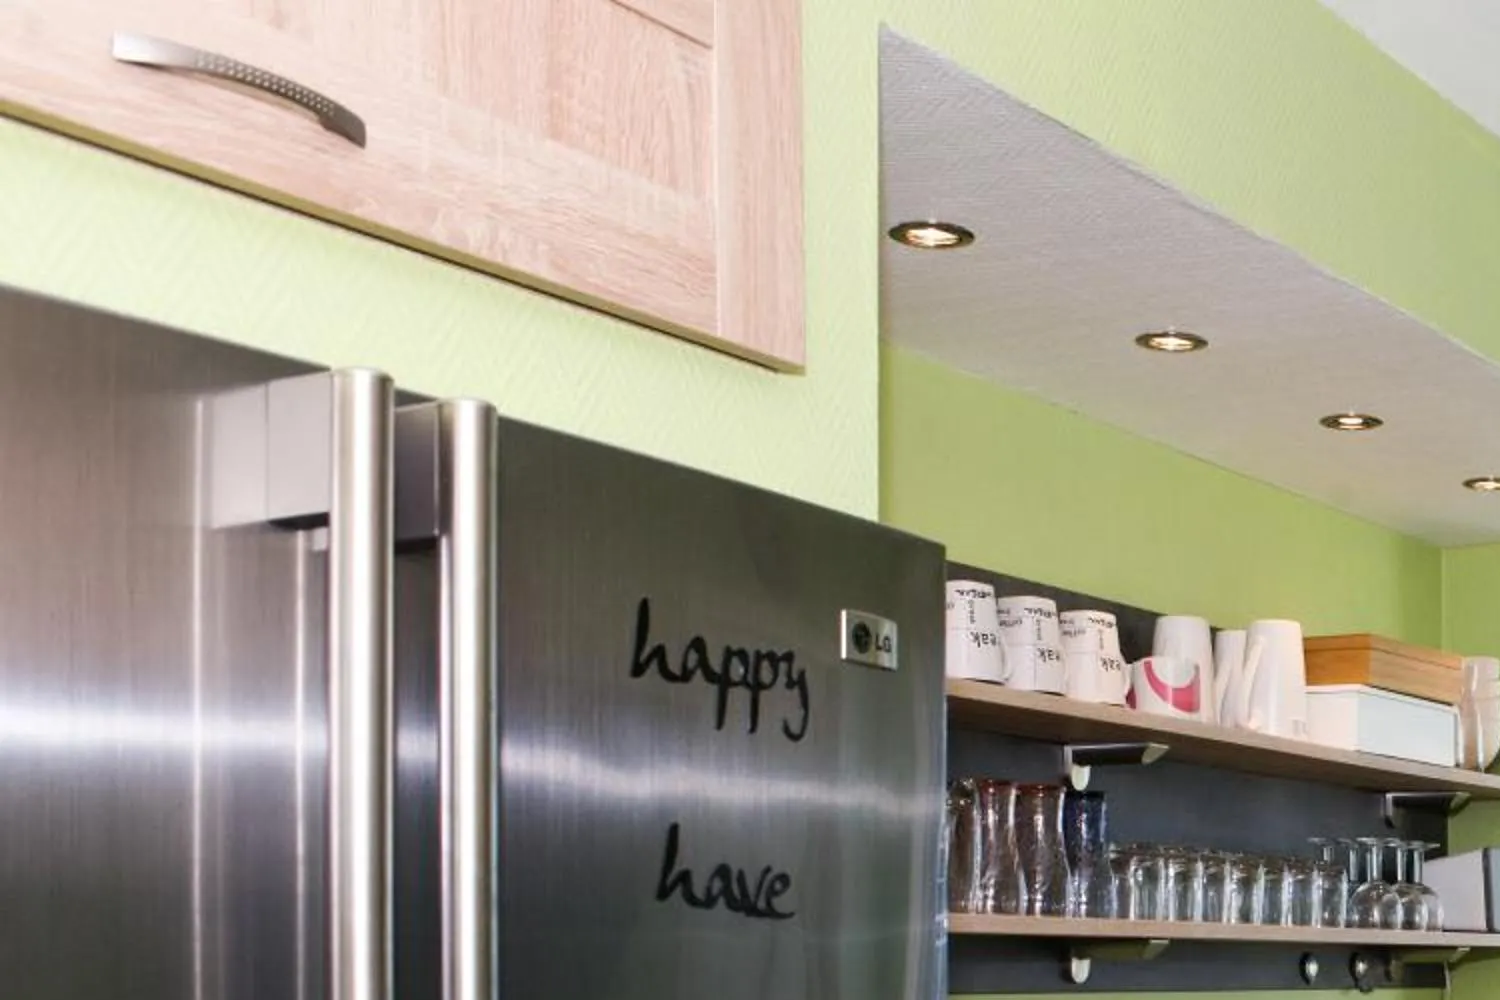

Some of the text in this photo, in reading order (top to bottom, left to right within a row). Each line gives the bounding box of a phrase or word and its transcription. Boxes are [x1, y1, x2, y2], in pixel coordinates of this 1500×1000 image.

[630, 597, 809, 741] happy
[874, 632, 893, 653] LG
[654, 823, 795, 919] have
